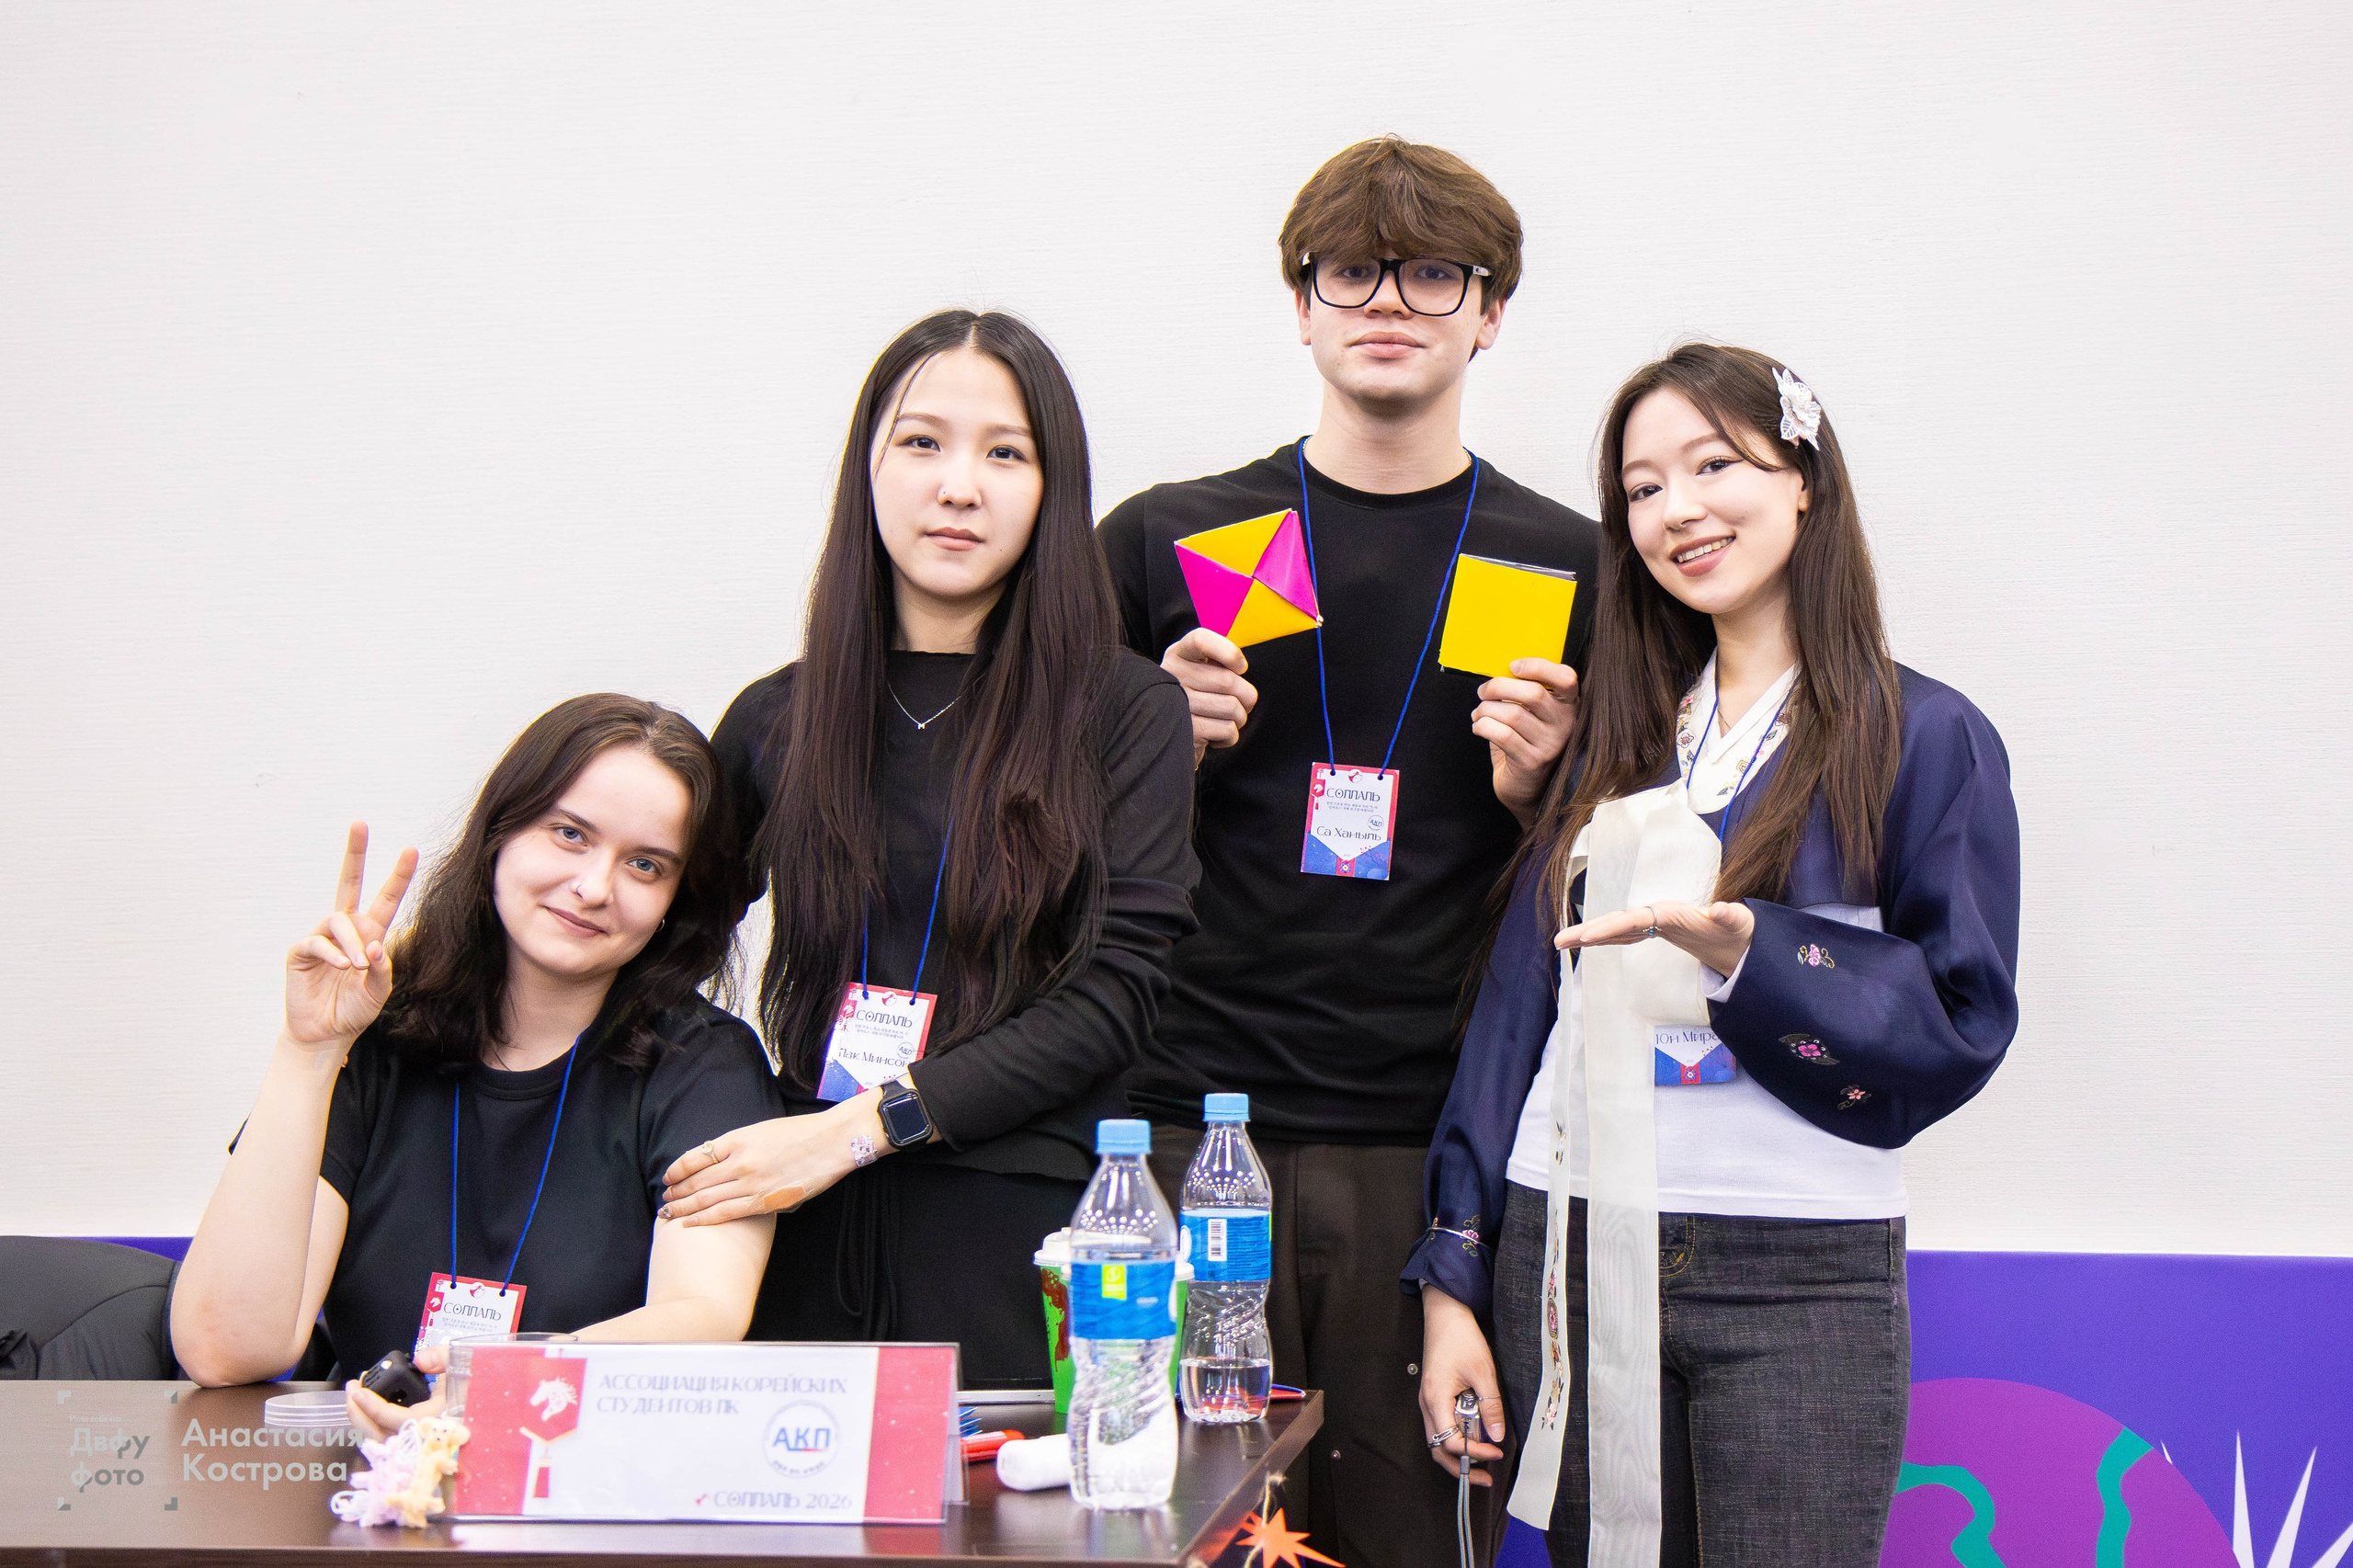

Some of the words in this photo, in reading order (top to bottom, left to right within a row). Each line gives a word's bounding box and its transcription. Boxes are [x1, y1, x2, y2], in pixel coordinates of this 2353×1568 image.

[1316, 825, 1332, 837] Са
[597, 1373, 729, 1392] АССОЦИАЦИЯ
[731, 1373, 848, 1394] КОРЕЙСКИХ
[596, 1396, 713, 1415] СТУДЕНТОВ
[772, 1426, 831, 1451] АКП
[805, 1493, 853, 1510] 2026
